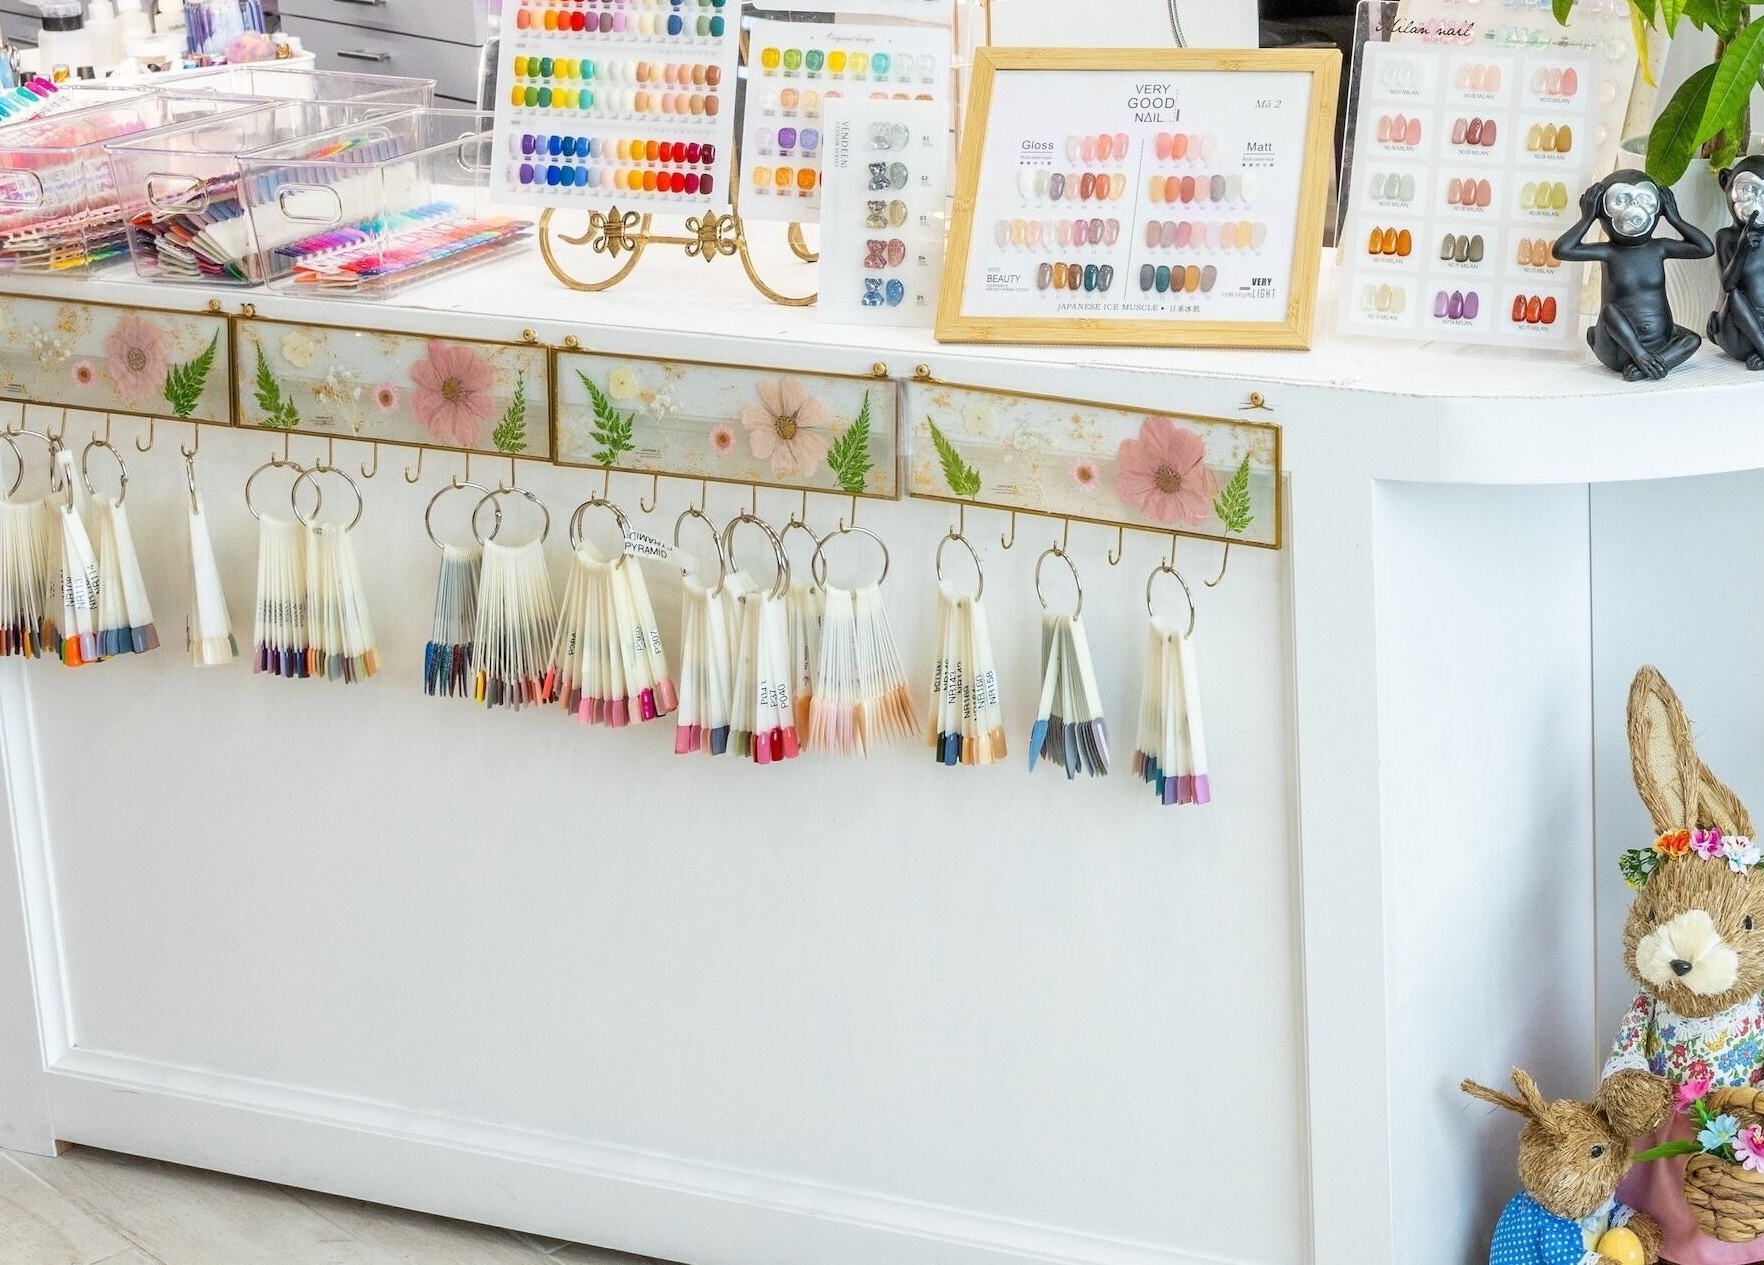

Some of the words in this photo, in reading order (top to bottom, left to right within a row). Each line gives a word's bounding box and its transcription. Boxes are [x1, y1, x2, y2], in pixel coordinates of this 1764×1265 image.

[1375, 15, 1431, 37] Milan
[1435, 22, 1476, 38] nail
[1135, 84, 1171, 95] VERY
[1127, 97, 1176, 109] GOOD
[1021, 139, 1055, 151] Gloss
[1246, 141, 1273, 152] Matt
[1471, 149, 1490, 157] MILAN
[1547, 153, 1565, 161] MILAN
[1391, 201, 1409, 209] MILAN
[1385, 257, 1404, 265] MILAN
[986, 274, 1021, 283] BEAUTY
[1251, 277, 1273, 286] VERY
[1252, 288, 1277, 300] LIGHT
[1056, 303, 1101, 312] JAPANESE
[1103, 303, 1119, 311] ICE
[1121, 304, 1159, 312] MUSCLE
[624, 541, 668, 559] PYRAMID
[650, 630, 662, 655] P307
[985, 670, 997, 705] NR158
[777, 683, 788, 709] P040
